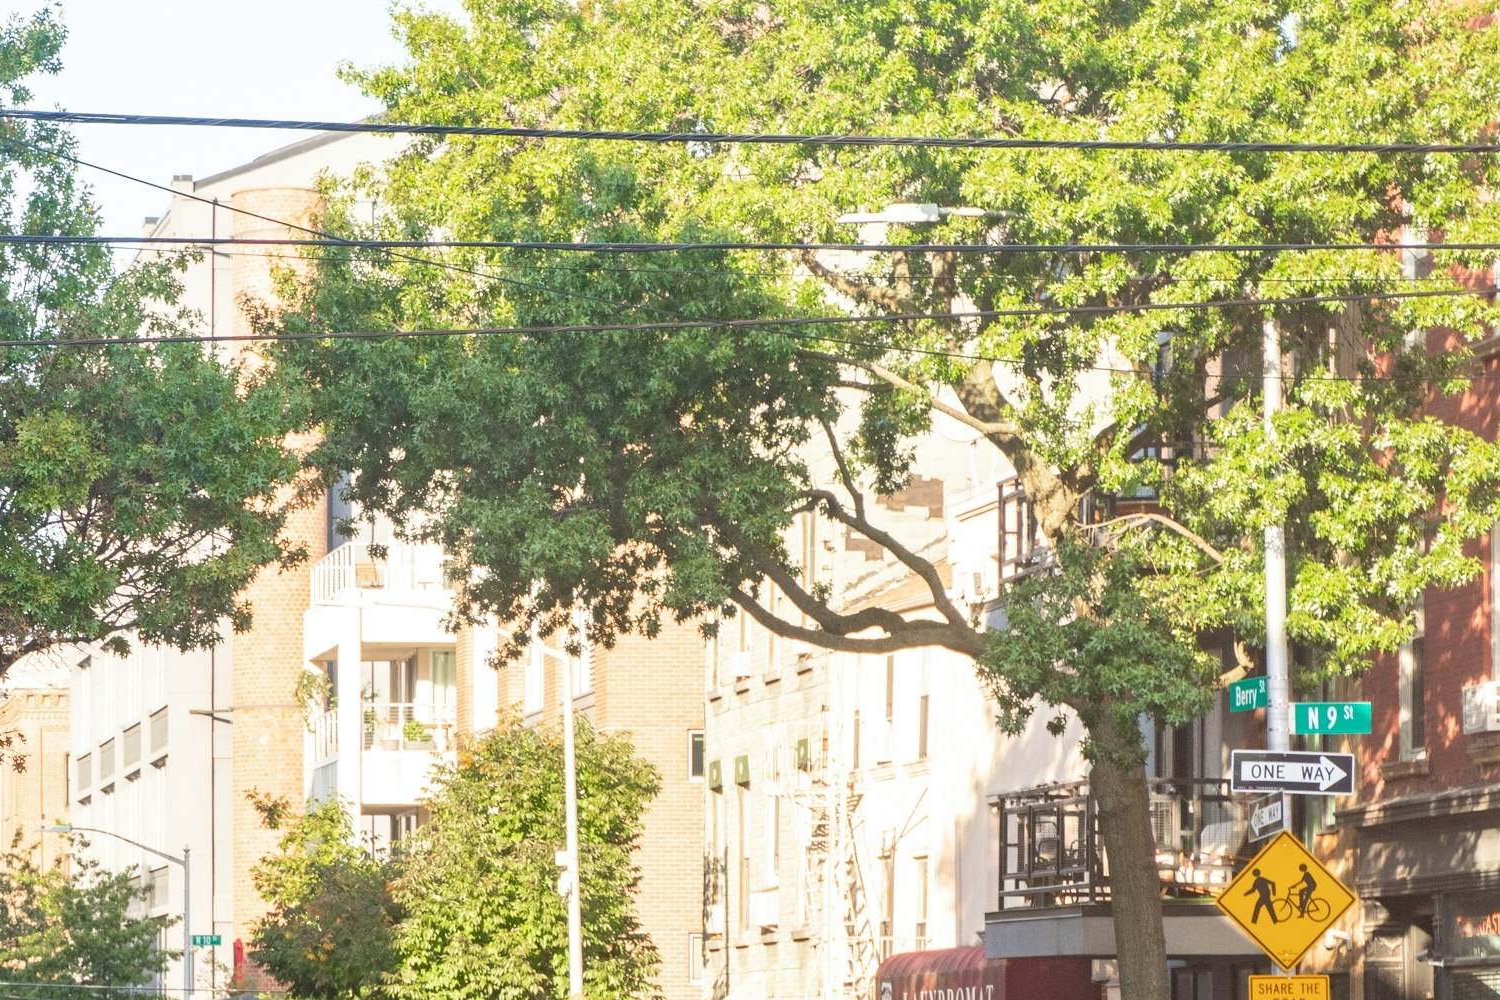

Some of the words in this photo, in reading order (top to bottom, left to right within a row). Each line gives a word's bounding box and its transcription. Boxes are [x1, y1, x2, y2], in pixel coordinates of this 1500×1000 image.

[1235, 685, 1257, 710] Berry
[1259, 679, 1266, 694] St
[1308, 706, 1319, 730] N
[1327, 706, 1338, 730] 9
[1343, 705, 1354, 720] St
[1251, 764, 1286, 779] ONE
[1301, 765, 1335, 781] WAY
[1253, 810, 1265, 828] ONE
[1268, 804, 1279, 820] WAY
[1258, 983, 1294, 995] SHARE
[1301, 983, 1320, 995] THE
